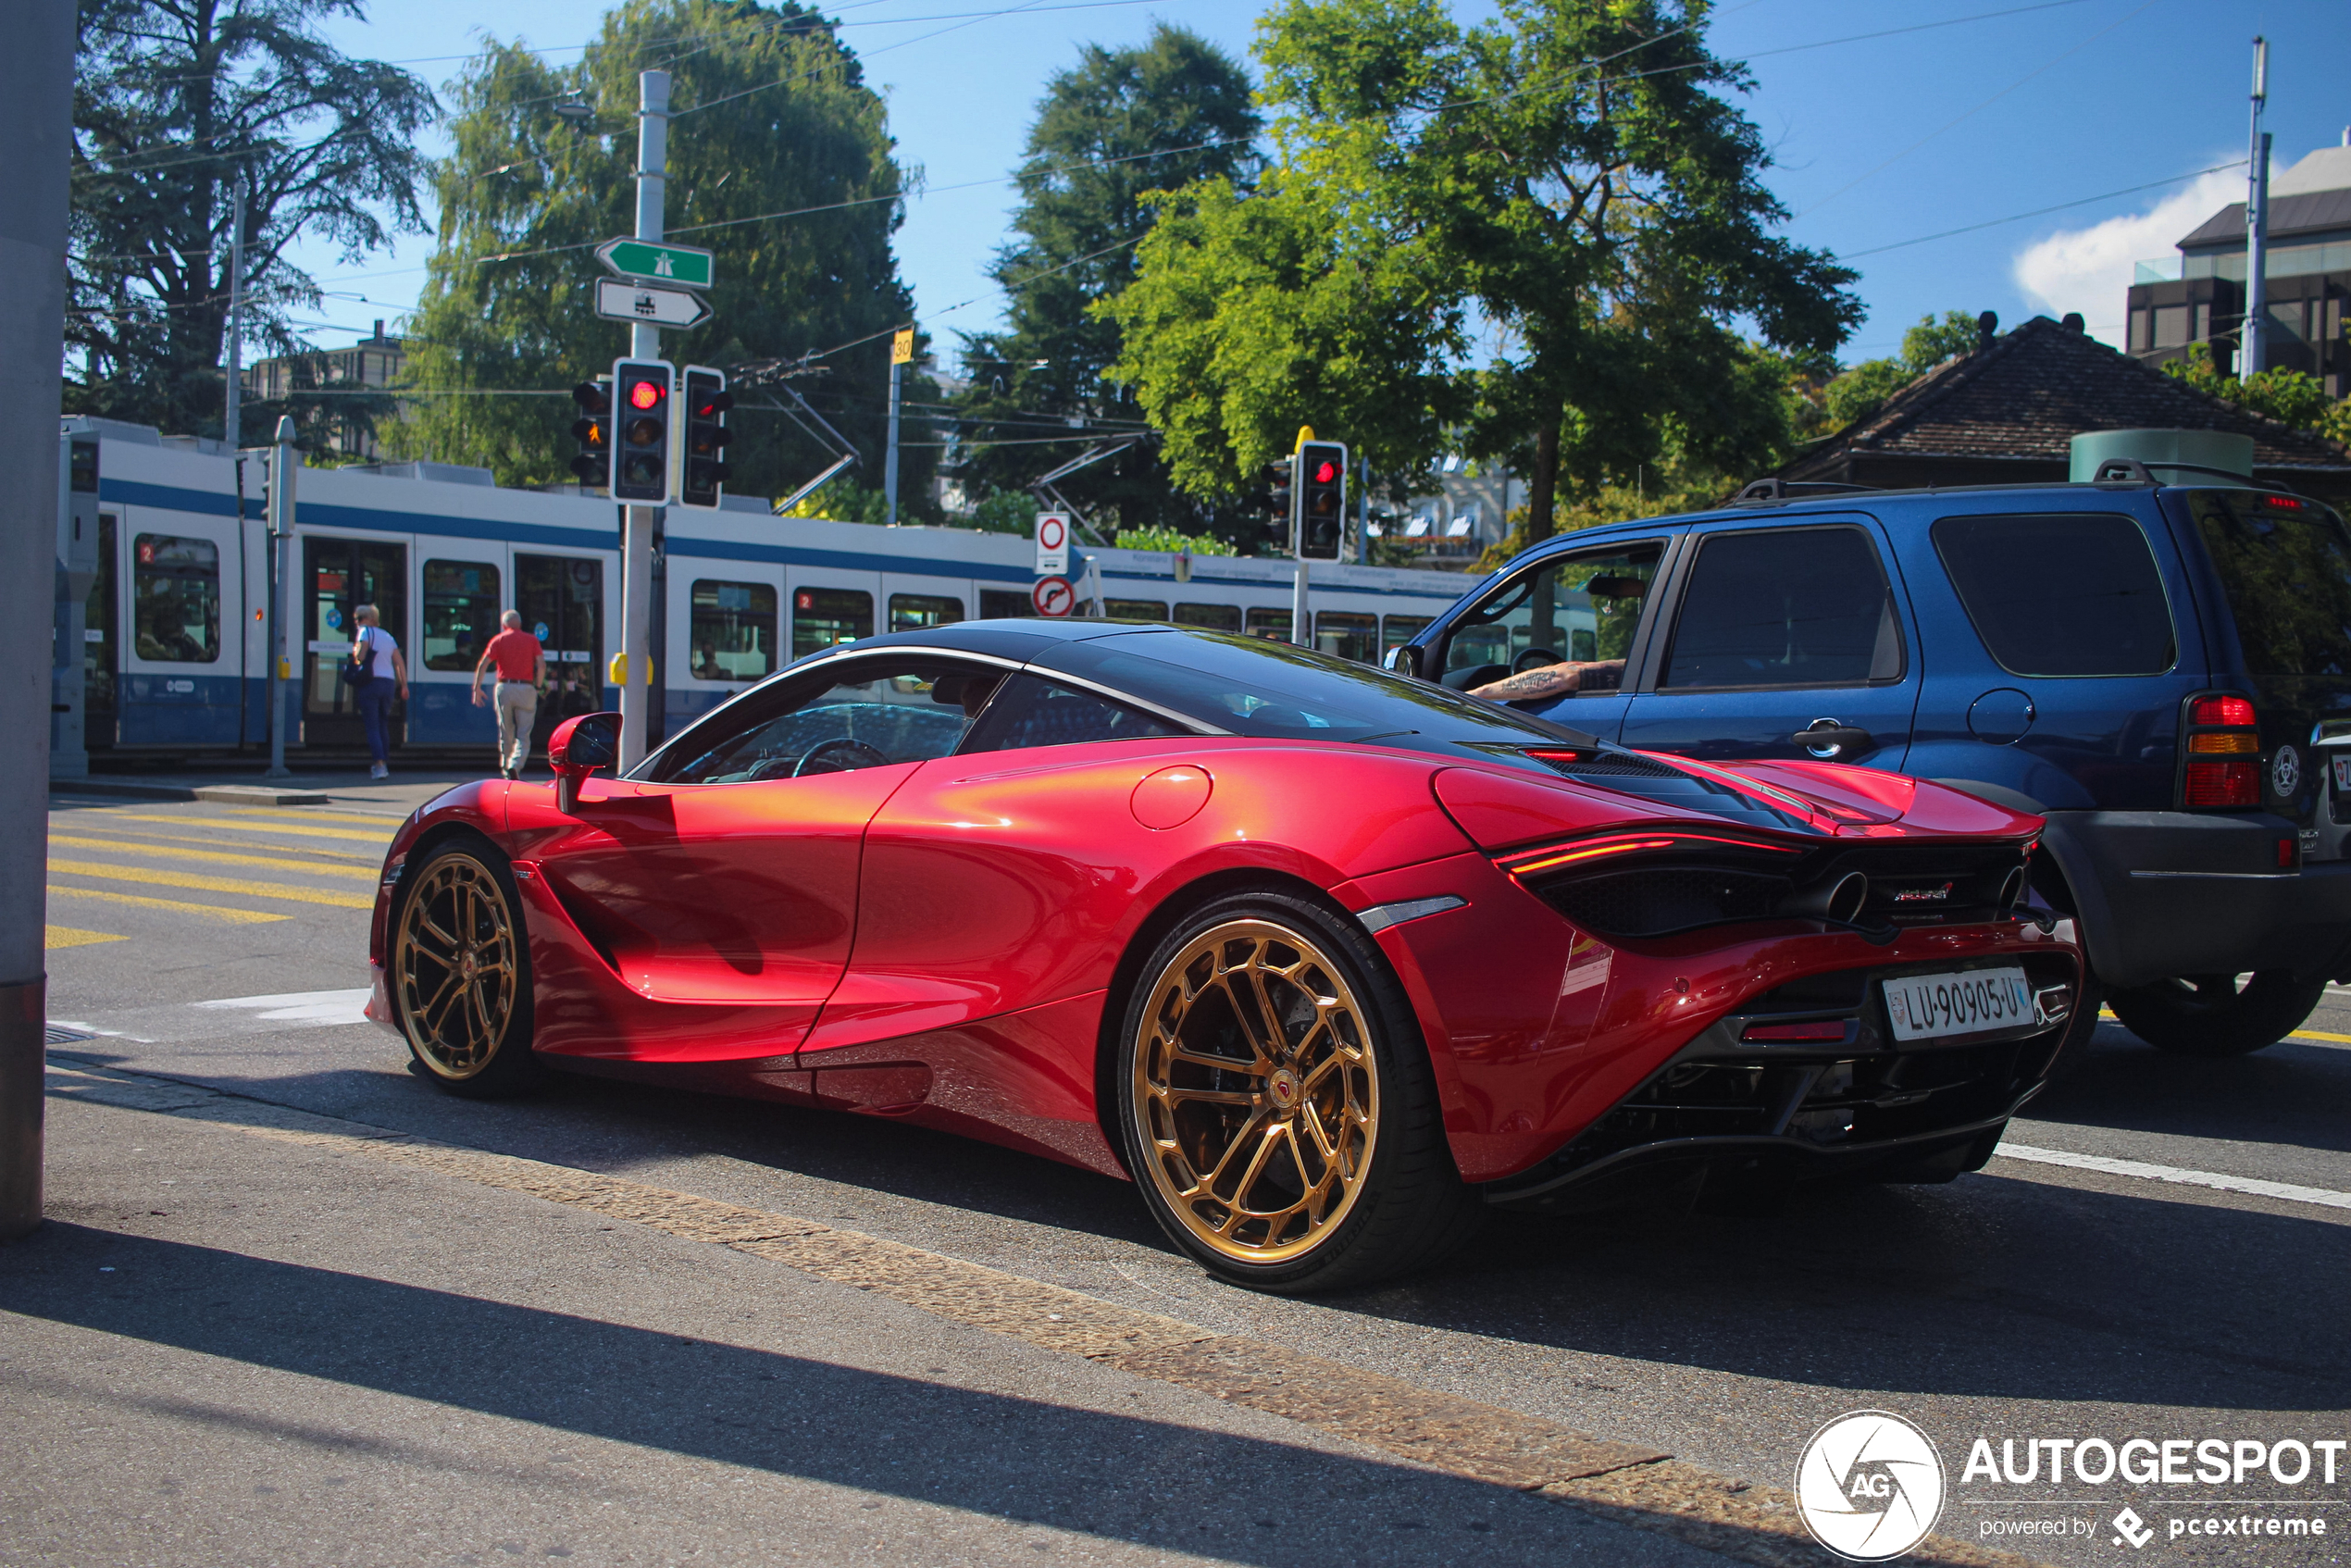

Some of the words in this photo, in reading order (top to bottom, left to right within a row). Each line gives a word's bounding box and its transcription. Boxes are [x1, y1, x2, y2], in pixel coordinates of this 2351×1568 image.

[895, 340, 911, 357] 30
[143, 545, 152, 562] 2
[802, 595, 810, 608] 2
